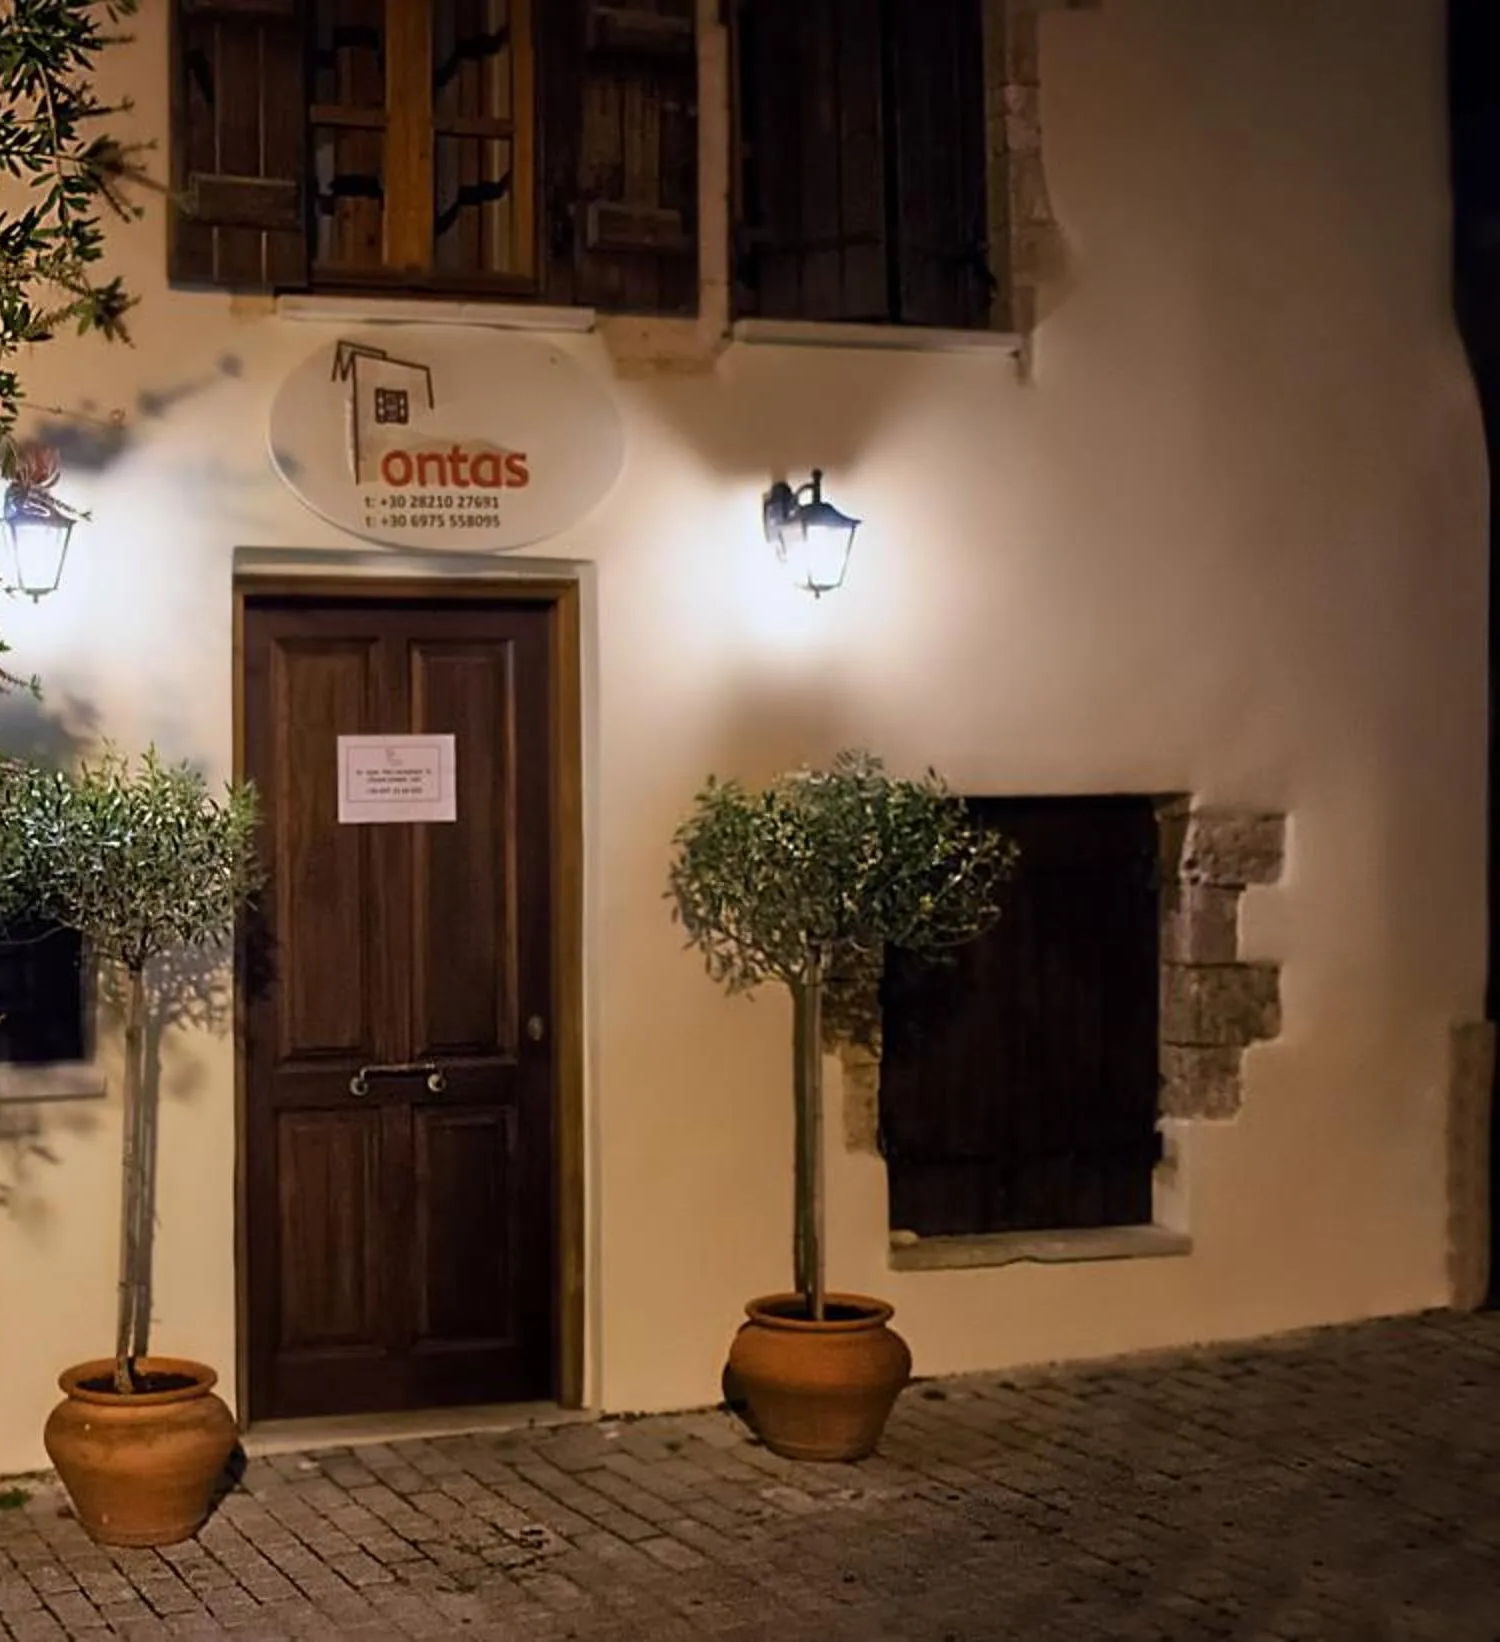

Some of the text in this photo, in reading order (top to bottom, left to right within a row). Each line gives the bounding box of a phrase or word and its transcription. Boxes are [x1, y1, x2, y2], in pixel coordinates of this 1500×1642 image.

[380, 496, 406, 509] +30
[410, 496, 453, 509] 28210
[381, 515, 407, 528] +30
[411, 515, 445, 528] 6975
